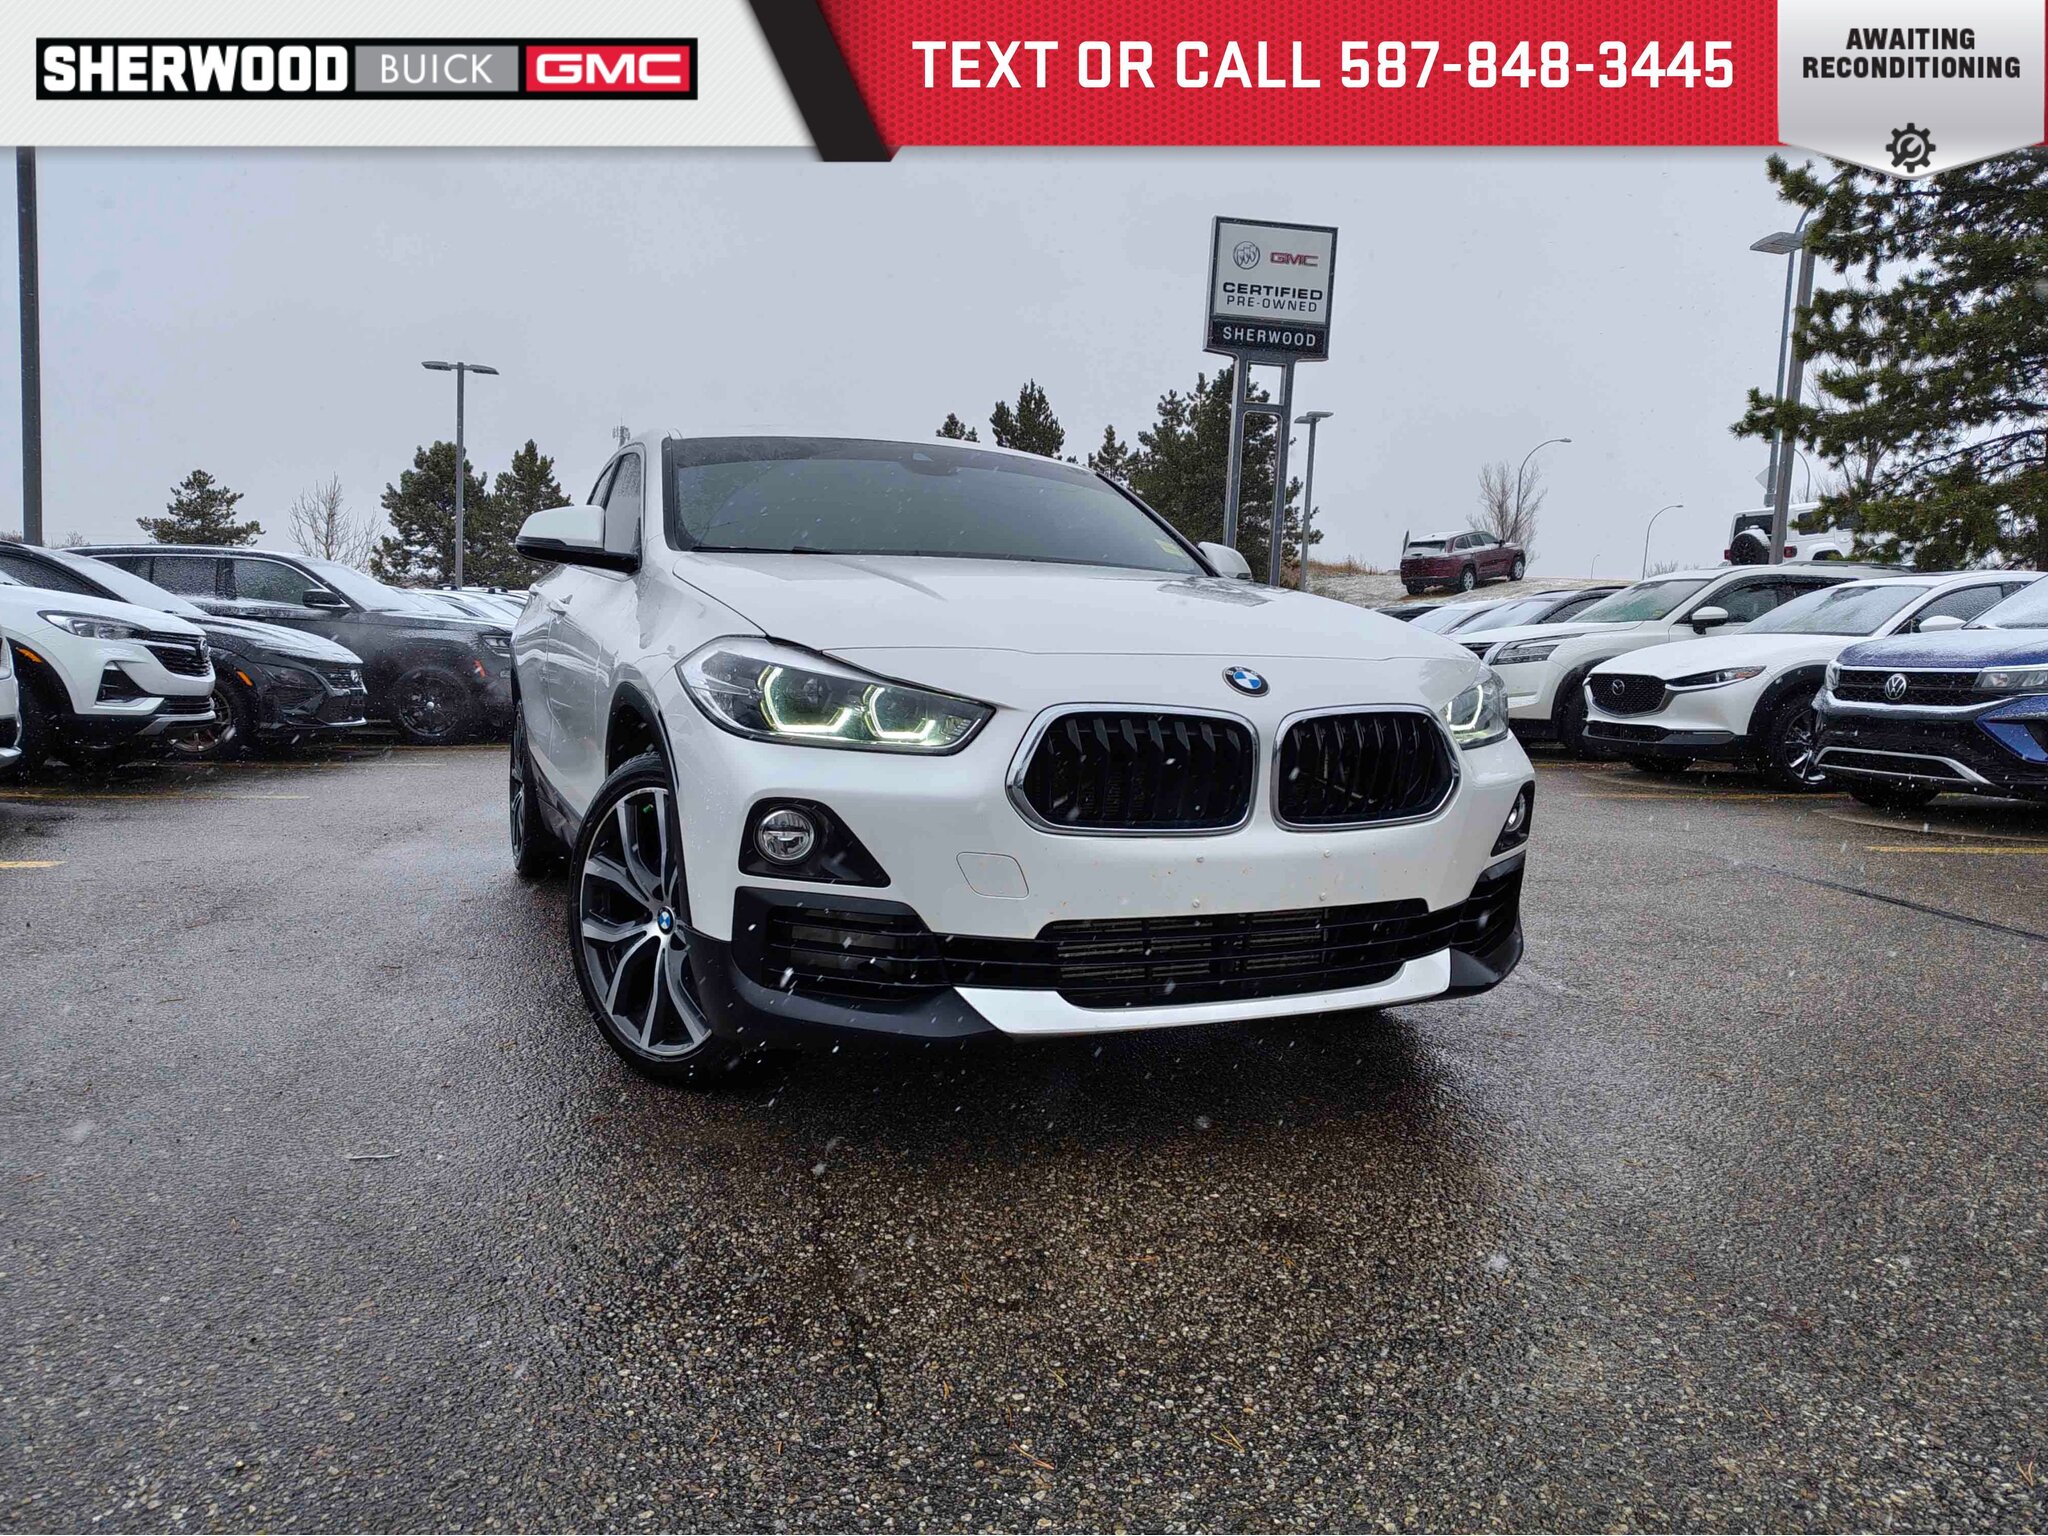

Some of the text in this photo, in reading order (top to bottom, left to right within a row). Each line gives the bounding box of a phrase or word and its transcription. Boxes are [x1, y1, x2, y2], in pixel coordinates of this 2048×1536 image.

[1270, 252, 1319, 267] GMC
[1223, 282, 1323, 300] CERTIFIED
[1227, 296, 1317, 312] PRE-OWNED
[1223, 327, 1316, 346] SHERWOOD
